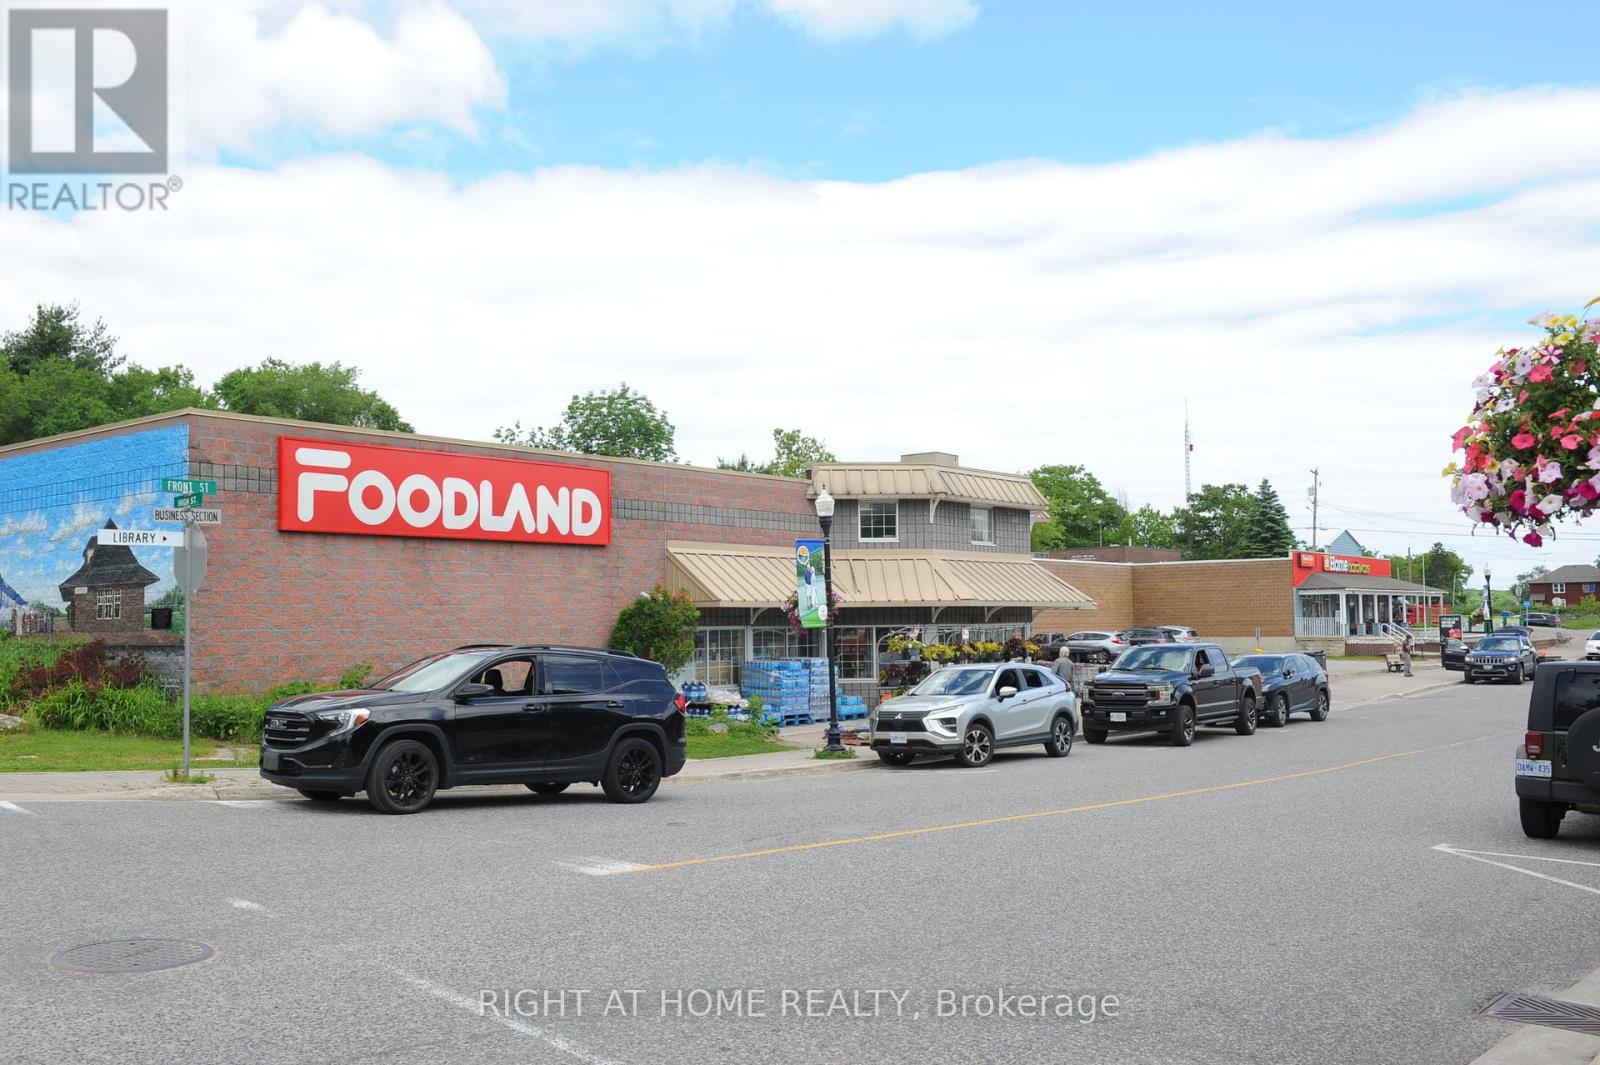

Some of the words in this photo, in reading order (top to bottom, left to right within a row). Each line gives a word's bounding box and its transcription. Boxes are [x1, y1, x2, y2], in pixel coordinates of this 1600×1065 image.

[167, 481, 193, 492] FRONT
[199, 482, 209, 493] ST
[294, 447, 602, 537] FOODLAND
[154, 510, 189, 521] BUSINESS
[191, 511, 218, 522] SECTION
[113, 532, 156, 543] LIBRARY
